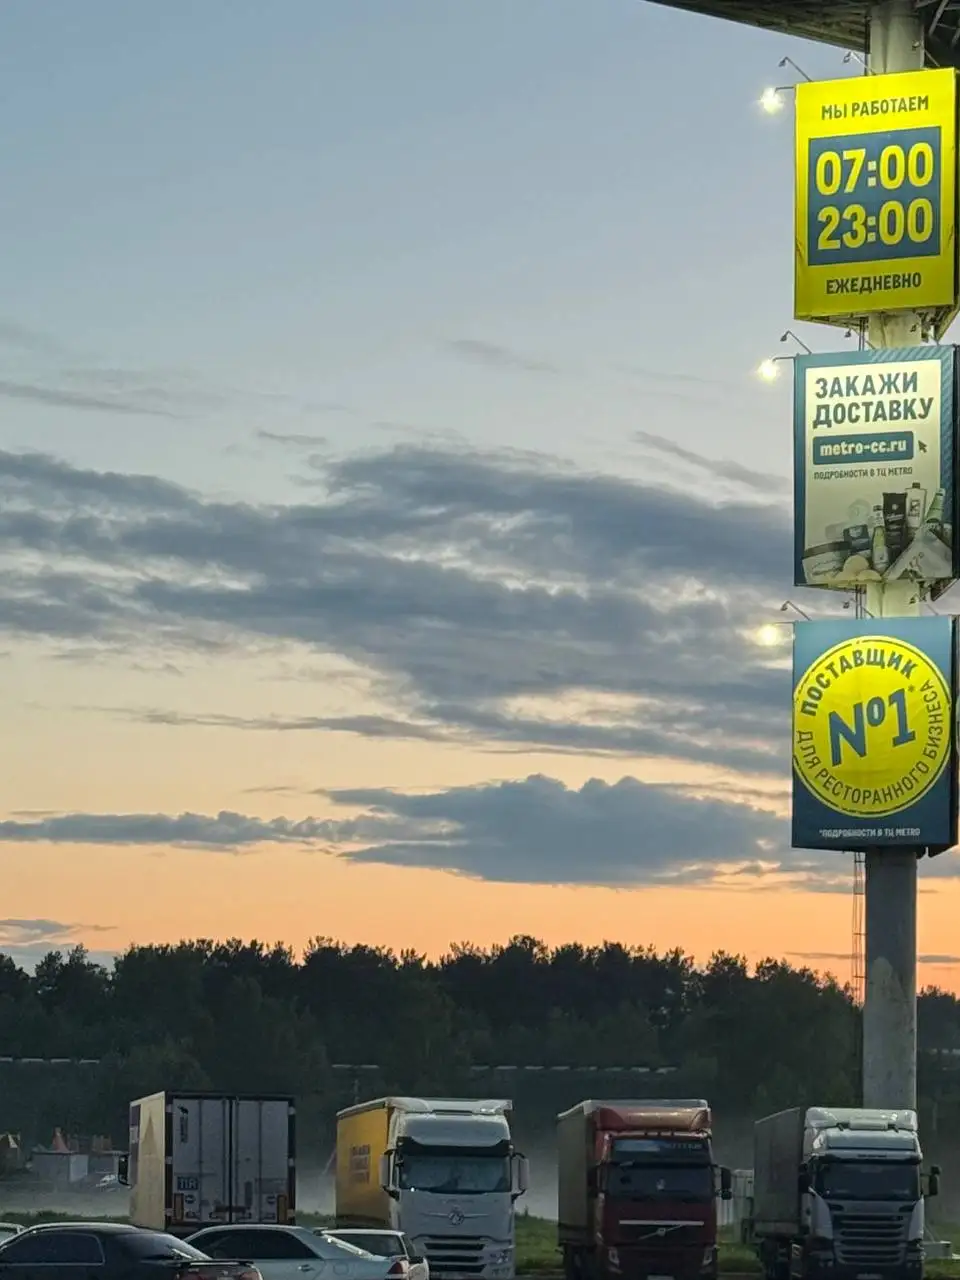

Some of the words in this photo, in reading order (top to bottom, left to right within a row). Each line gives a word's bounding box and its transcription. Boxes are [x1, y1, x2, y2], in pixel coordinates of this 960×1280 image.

[821, 104, 848, 121] МЫ
[851, 95, 929, 118] РАБОТАЕМ
[815, 142, 934, 196] 07:00
[817, 198, 933, 250] 23:00
[826, 272, 922, 294] ЕЖЕДНЕВНО
[815, 371, 918, 399] ЗАКАЖИ
[812, 397, 934, 429] ДОСТАВКУ
[819, 439, 907, 457] metro-cc.ru
[800, 648, 919, 717] ПОСТАВЩИК
[797, 730, 821, 769] ДЛЯ
[815, 760, 930, 805] РЕСТОРАННОГО
[920, 679, 944, 761] БИЗНЕСА
